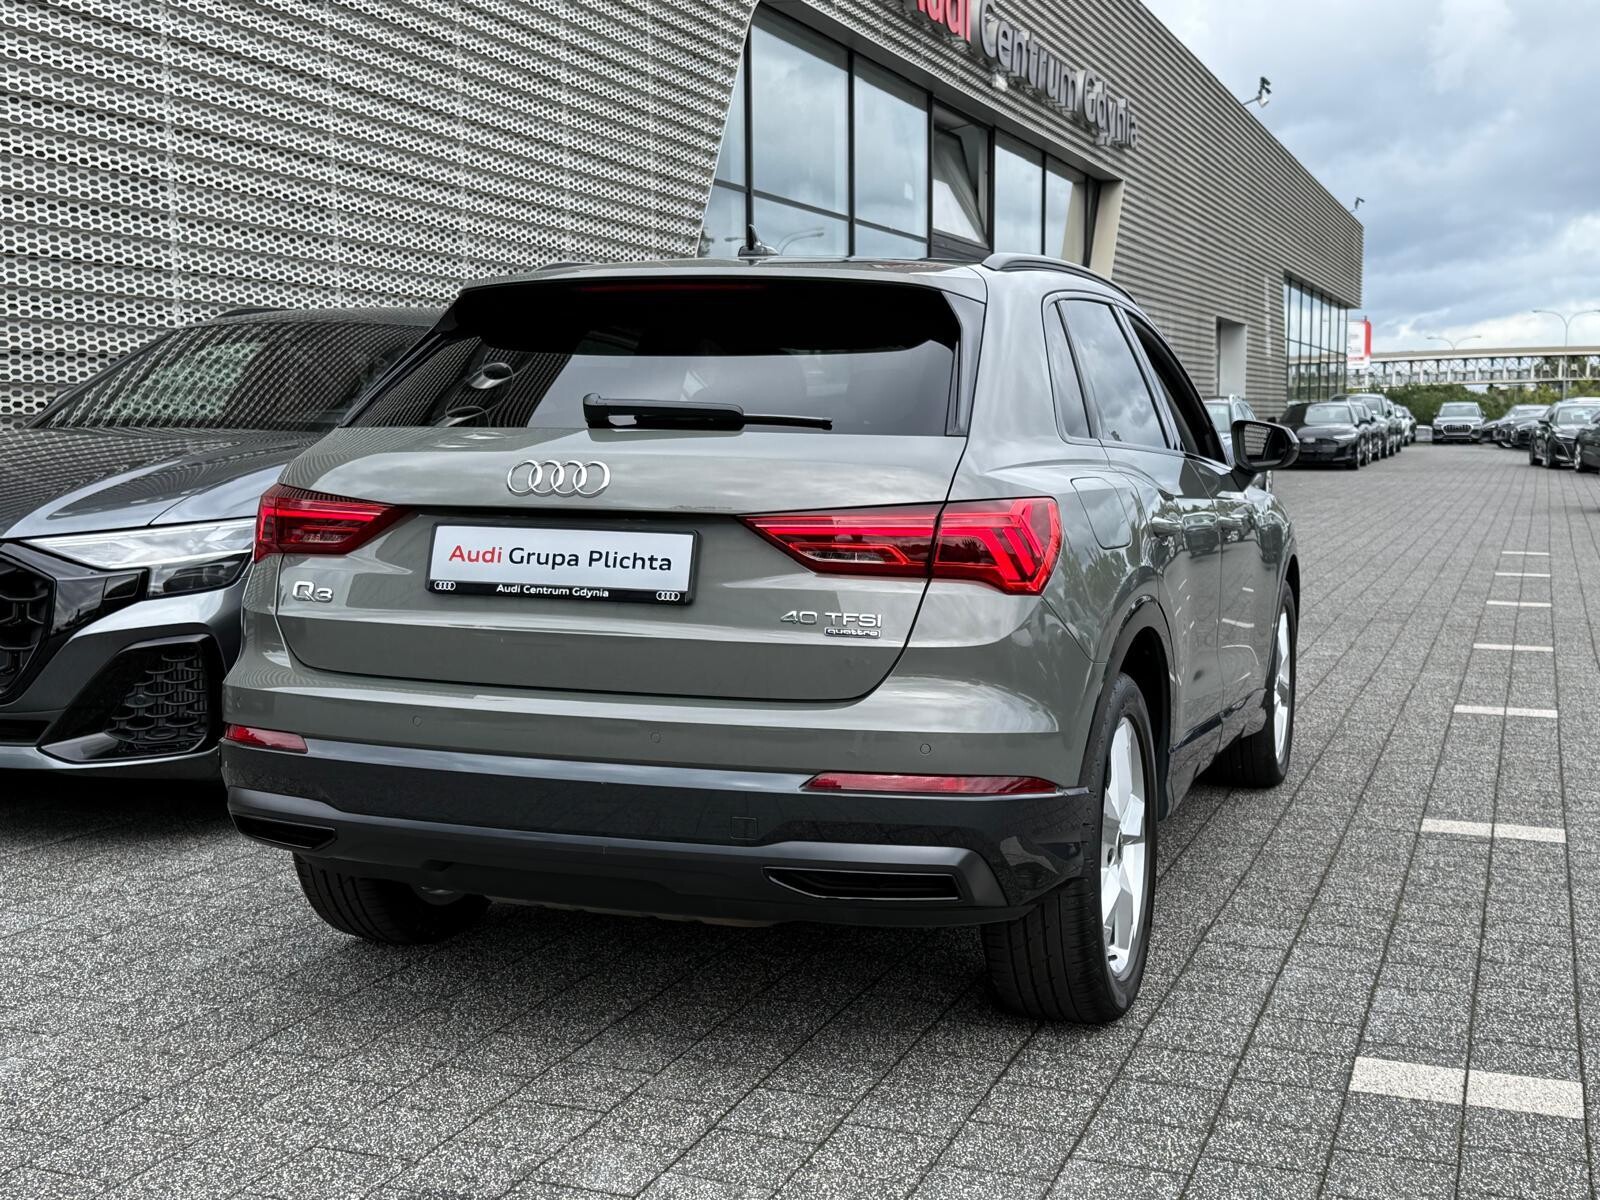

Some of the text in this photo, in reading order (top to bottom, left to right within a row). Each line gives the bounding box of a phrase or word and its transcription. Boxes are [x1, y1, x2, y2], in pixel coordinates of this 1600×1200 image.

[980, 0, 1077, 111] Centrum
[1082, 69, 1138, 148] Gdynia
[448, 545, 672, 571] Audi Grupa Plichta
[292, 581, 333, 603] Q3
[496, 584, 609, 598] Audi Centrum Gdynia
[780, 610, 882, 628] 40 TFSI
[826, 628, 879, 637] quattro
